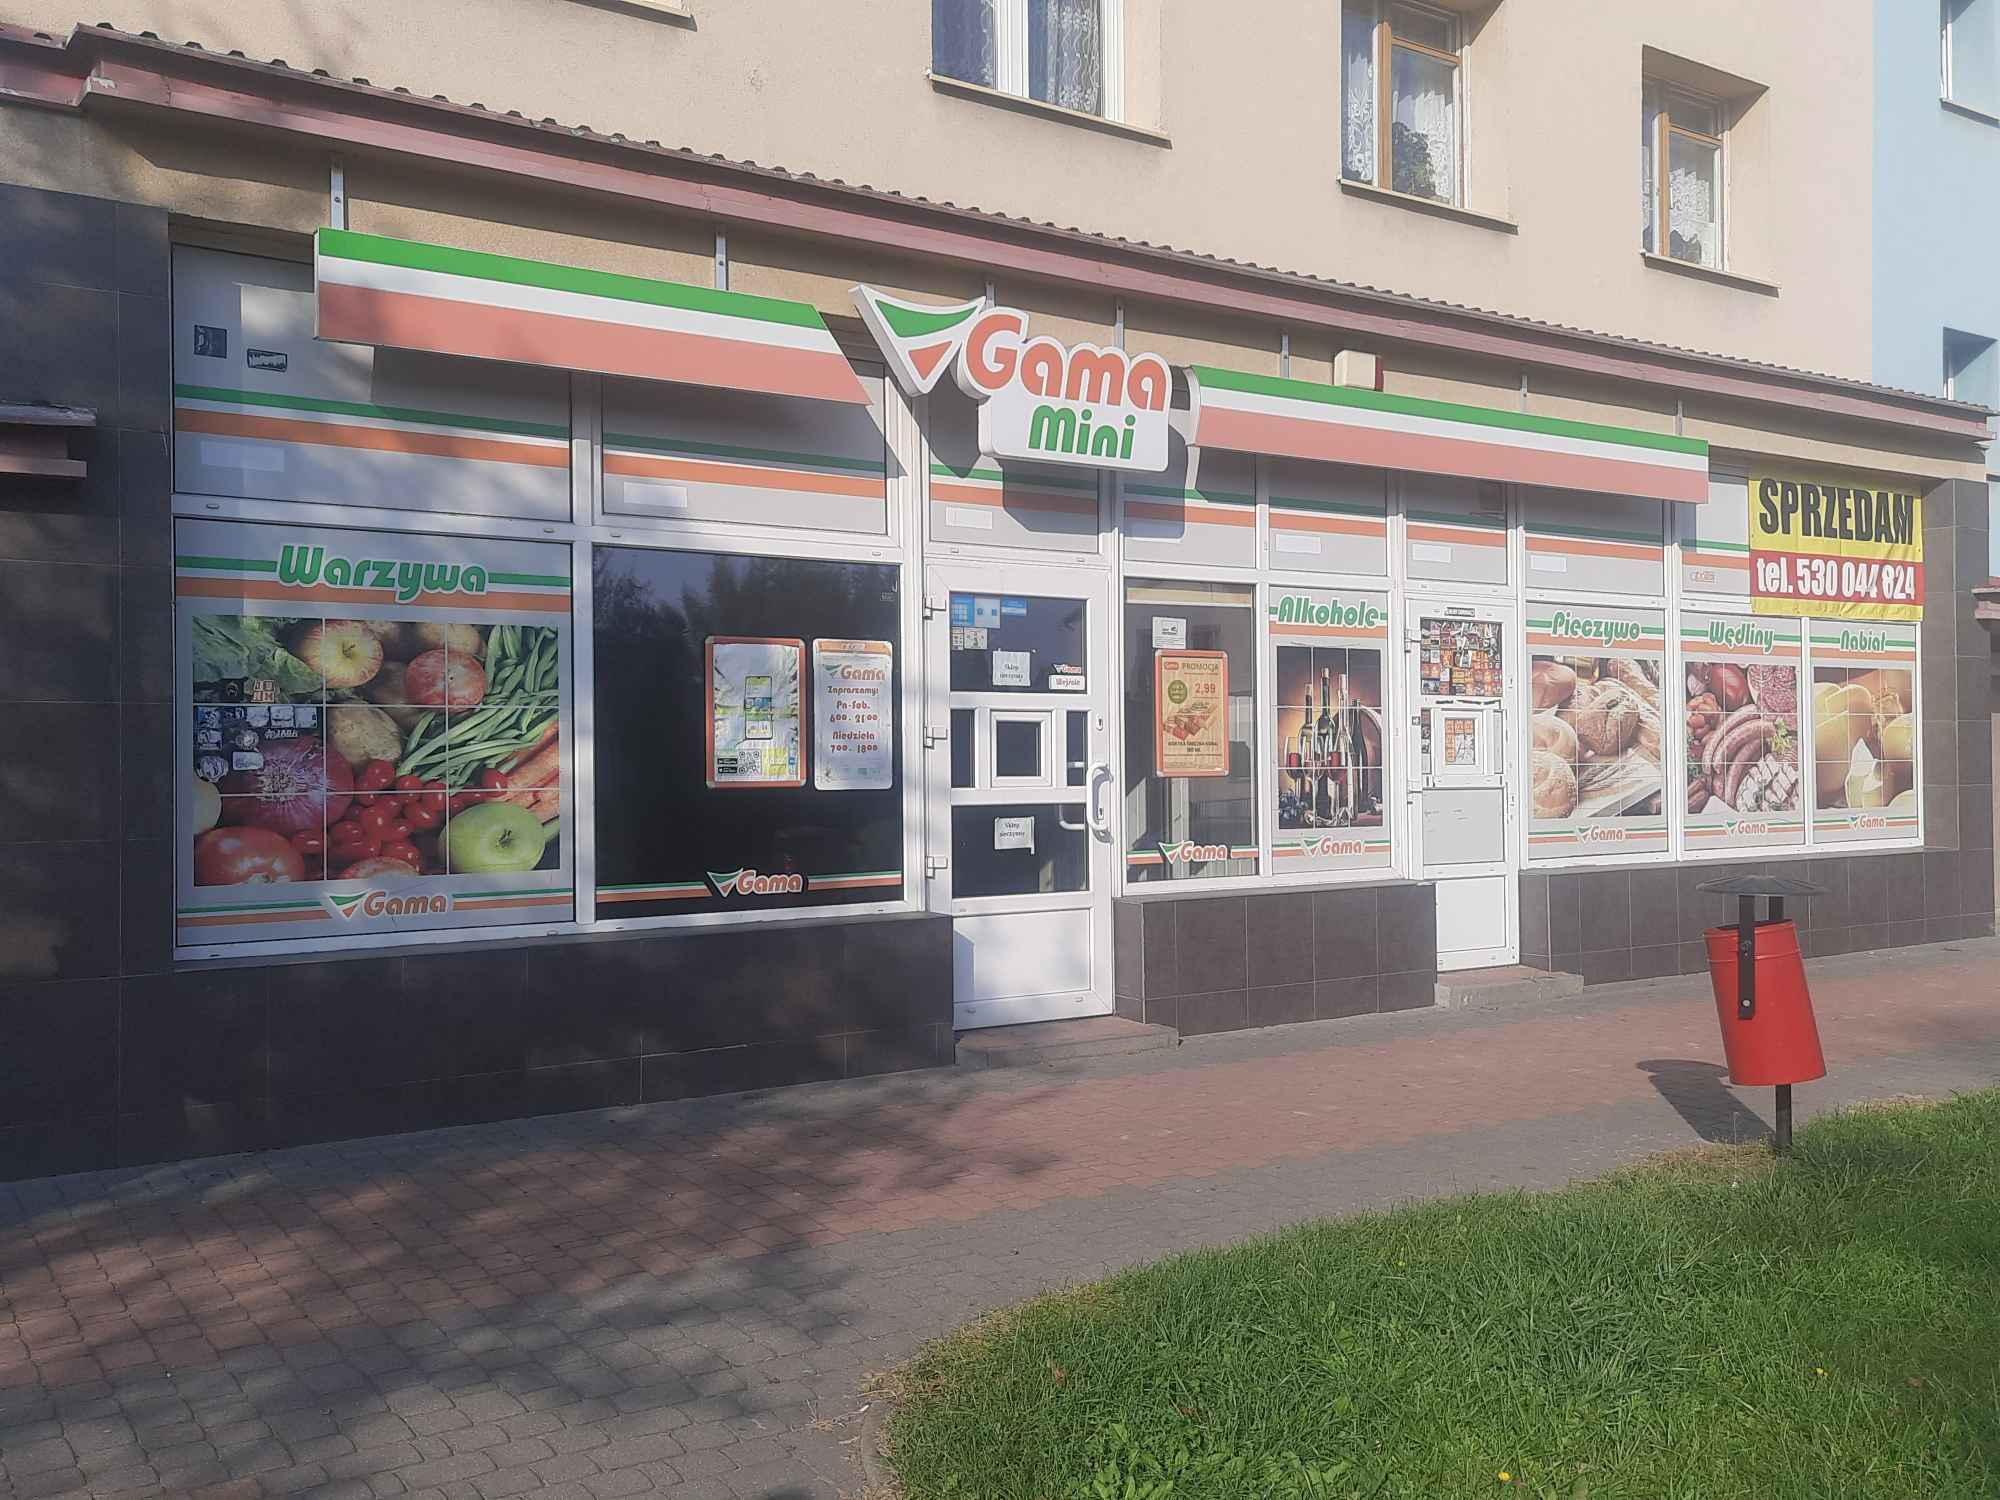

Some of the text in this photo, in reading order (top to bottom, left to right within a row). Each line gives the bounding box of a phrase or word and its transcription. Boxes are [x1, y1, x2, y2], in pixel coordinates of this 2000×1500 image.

[965, 313, 1167, 412] Gama
[1028, 404, 1136, 460] Mini
[1758, 478, 1914, 546] SPRZEDAM
[279, 544, 488, 600] Warzywa
[1756, 557, 1793, 594] tel.
[1796, 558, 1838, 597] 530
[1881, 564, 1916, 600] 824
[1278, 596, 1379, 627] Alkohole
[1551, 611, 1641, 646] Pieczywo
[1708, 621, 1775, 653] Wędliny
[841, 664, 886, 681] Gama
[1590, 825, 1624, 841] Gama
[1737, 820, 1768, 836] Gama
[1858, 815, 1886, 829] Gama
[1180, 841, 1227, 861] Gama
[1320, 837, 1363, 856] Gama
[736, 869, 804, 895] Gama
[365, 891, 447, 916] Gama
